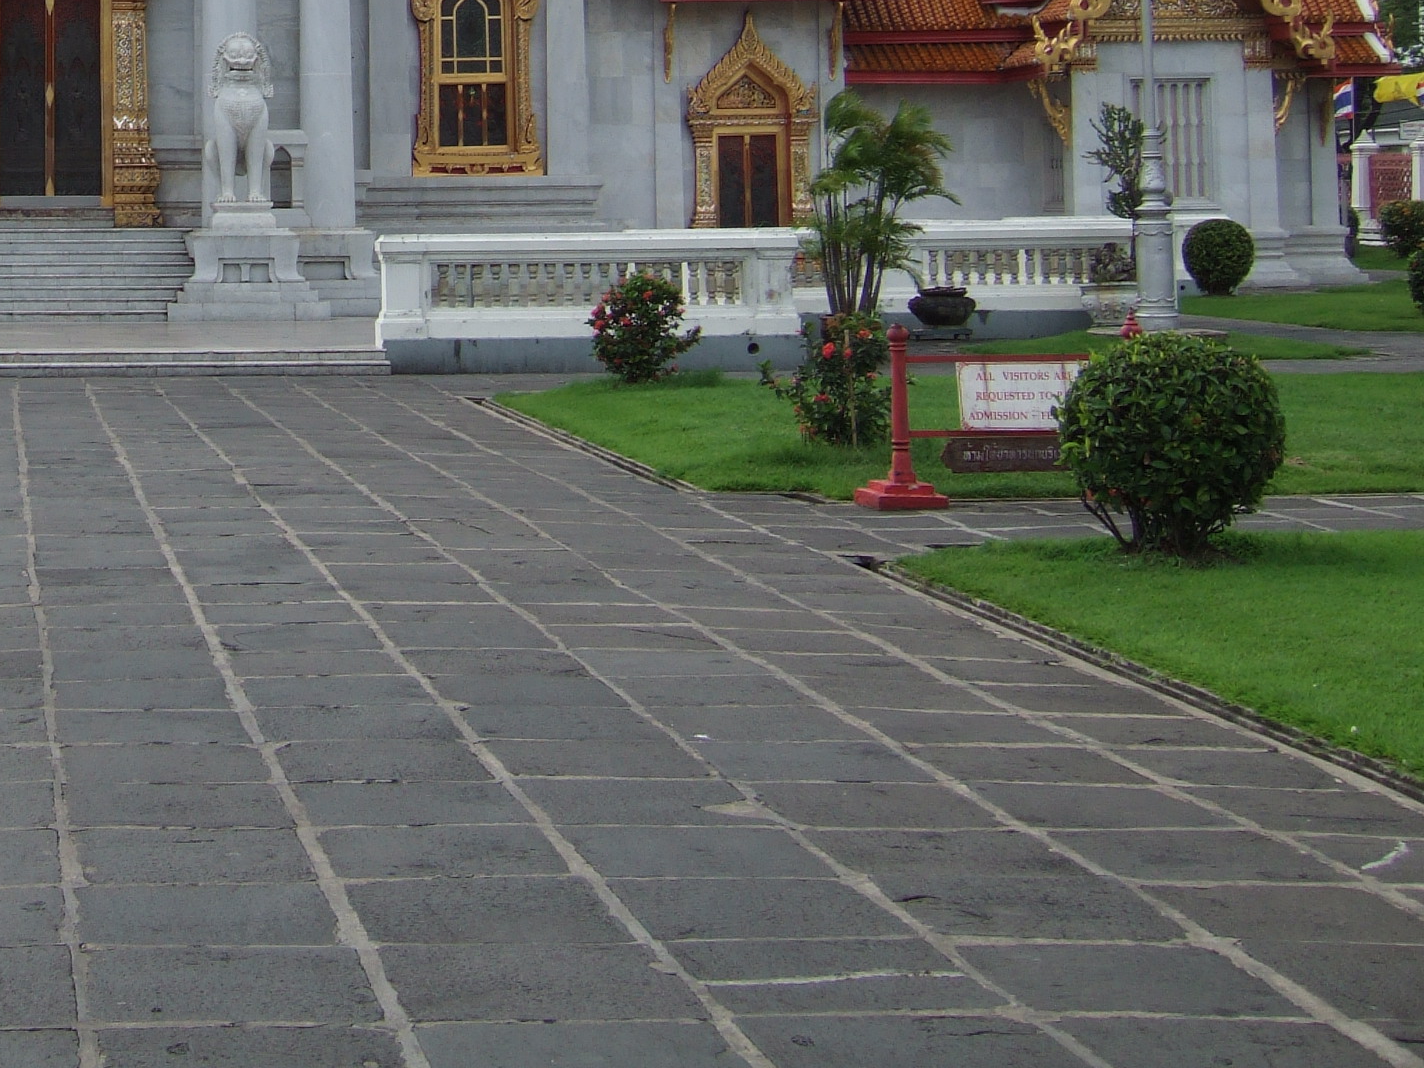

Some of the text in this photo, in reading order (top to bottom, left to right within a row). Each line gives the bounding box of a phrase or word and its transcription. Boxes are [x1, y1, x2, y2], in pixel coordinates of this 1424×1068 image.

[975, 371, 1074, 381] ALL VISITORS ARE
[975, 391, 1036, 402] REQUESTED
[1038, 391, 1053, 400] TO
[968, 411, 1028, 420] ADMISSION
